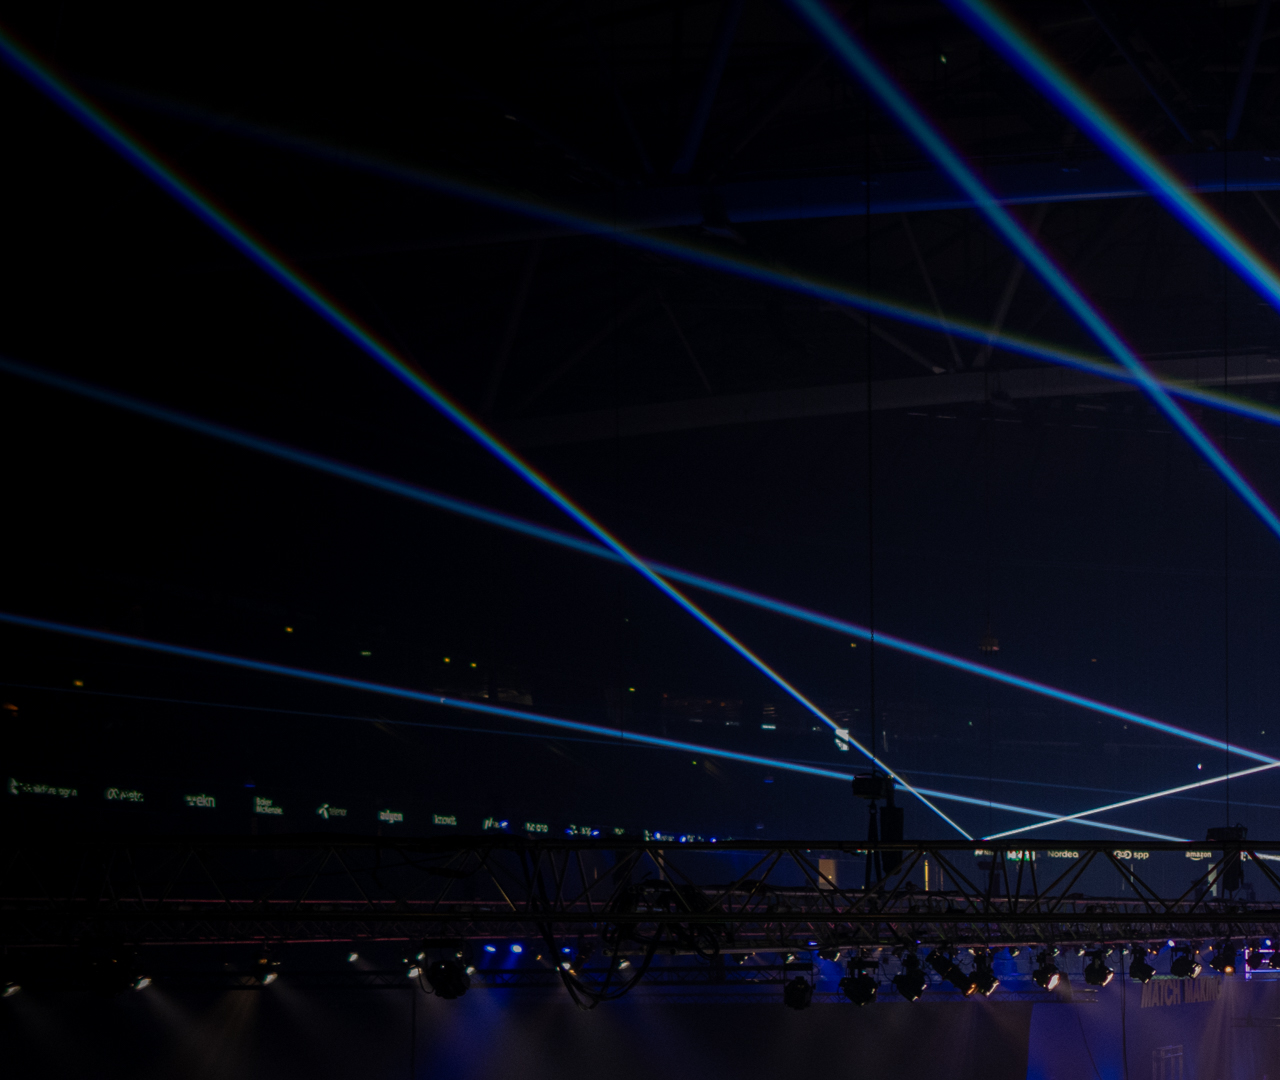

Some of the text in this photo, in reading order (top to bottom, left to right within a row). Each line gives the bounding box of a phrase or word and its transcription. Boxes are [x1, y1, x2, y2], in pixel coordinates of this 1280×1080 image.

[1047, 850, 1080, 859] Nordea
[1185, 851, 1212, 859] amazon
[1140, 975, 1222, 1008] MATCH MAKING
